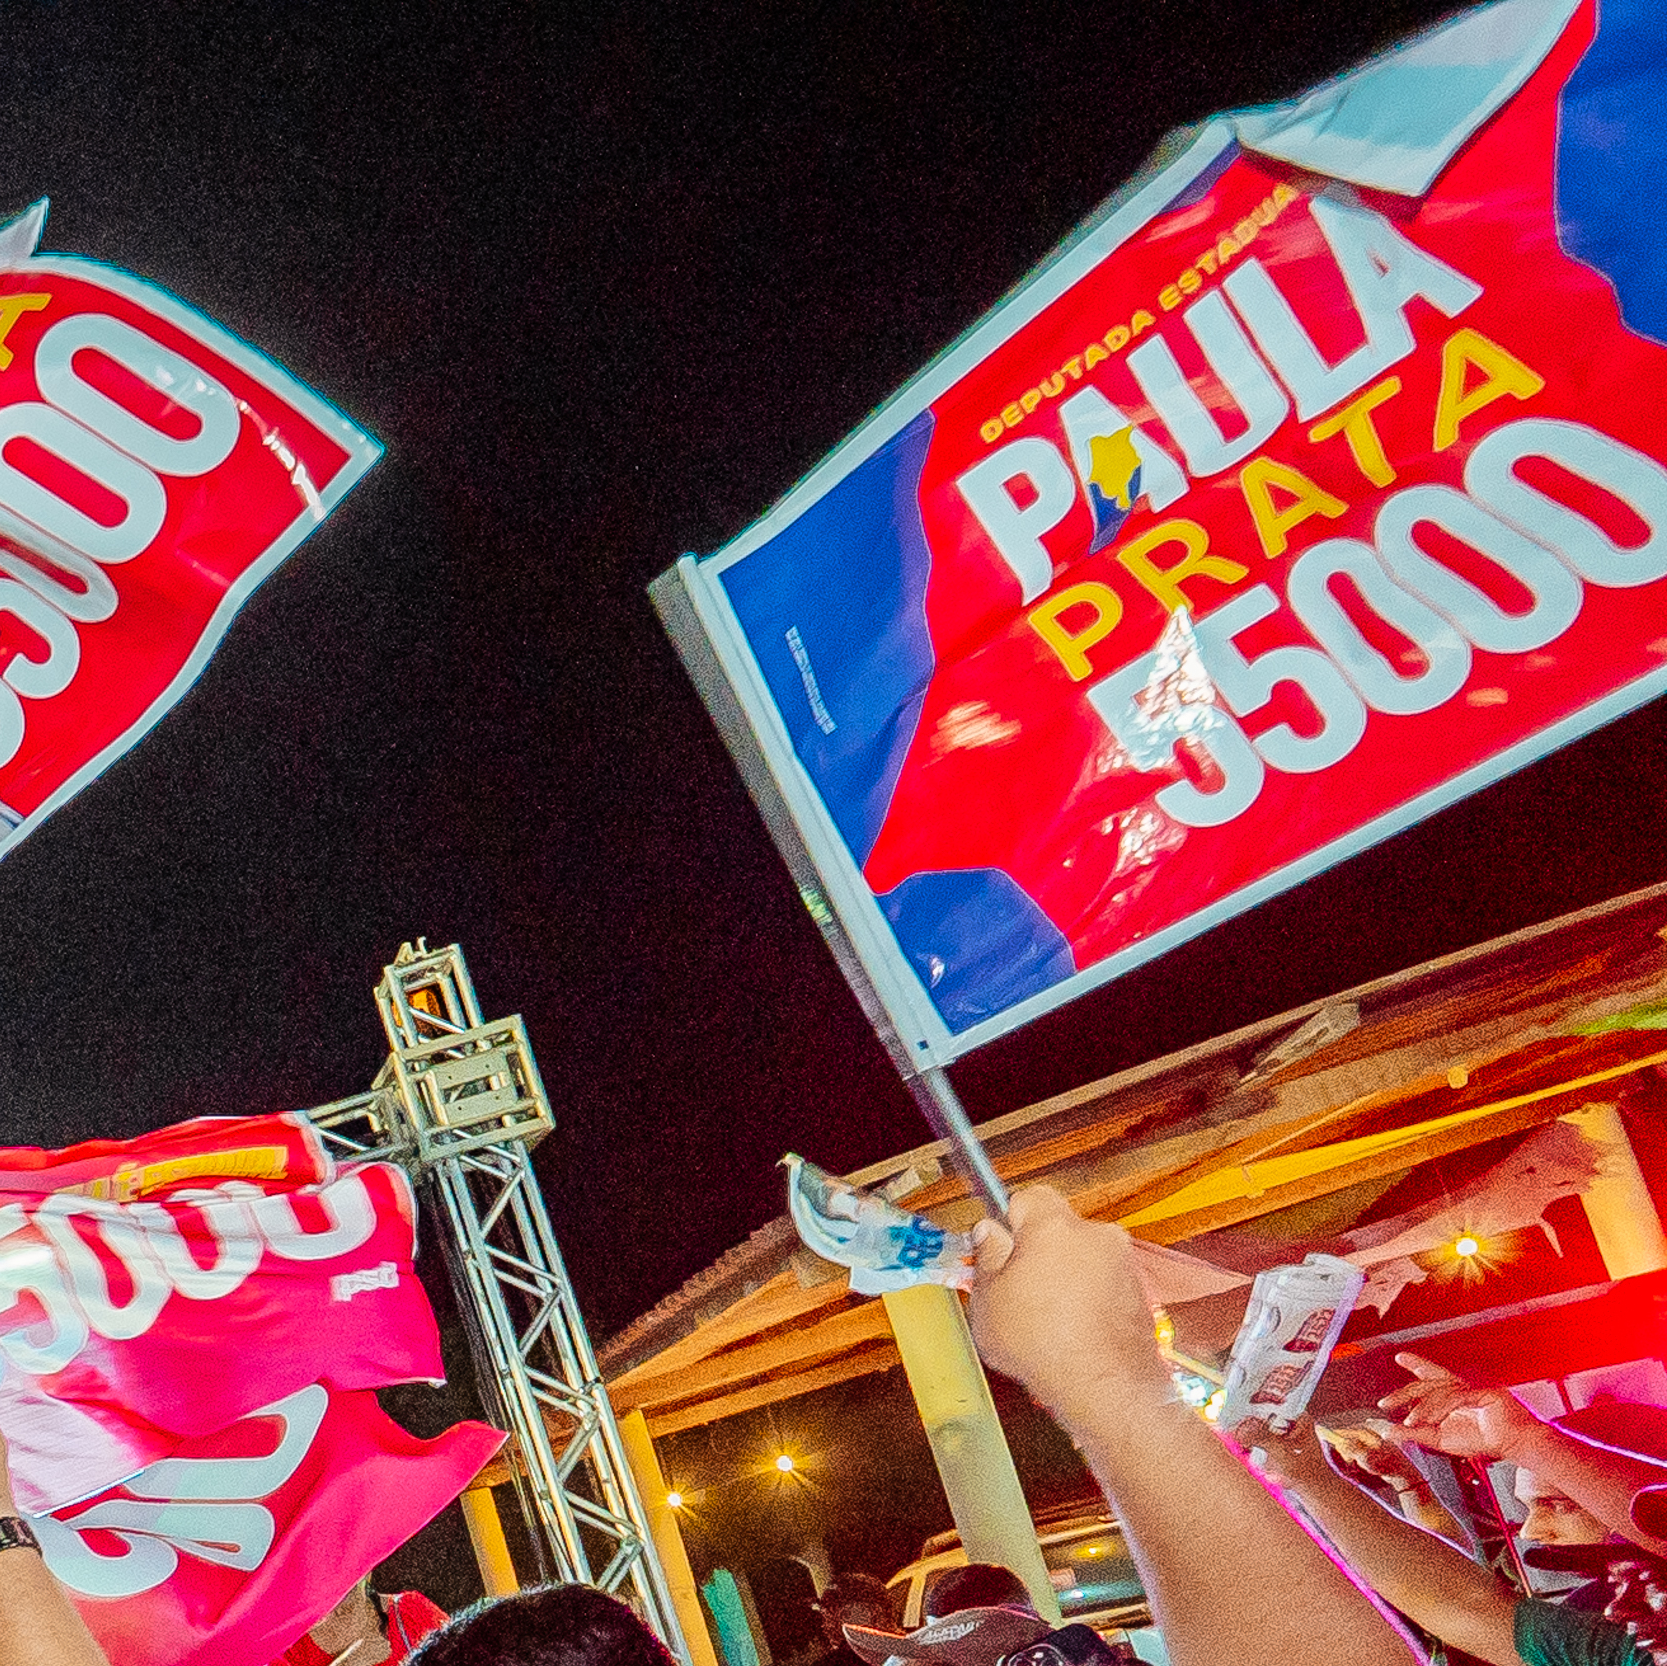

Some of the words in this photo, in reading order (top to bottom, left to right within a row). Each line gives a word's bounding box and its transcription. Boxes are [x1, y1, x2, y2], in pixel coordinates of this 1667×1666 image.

[956, 195, 1484, 606] PAULA
[979, 309, 1157, 443] DEPUTADA
[1157, 182, 1299, 312] ESTADUA
[1026, 327, 1547, 681] PRATA
[1085, 417, 1667, 828] 55000
